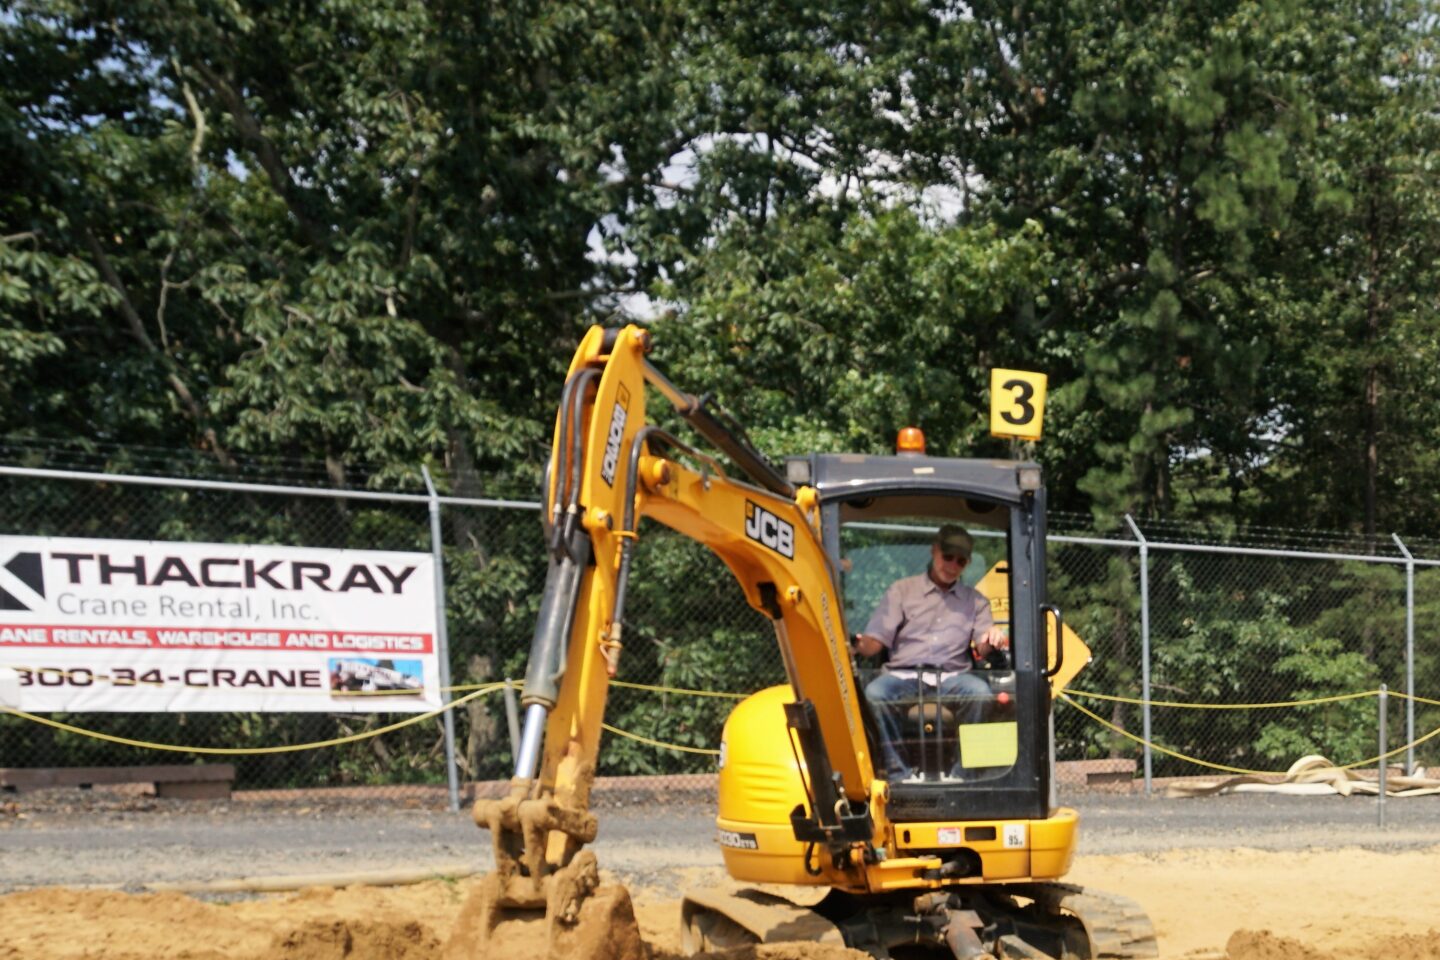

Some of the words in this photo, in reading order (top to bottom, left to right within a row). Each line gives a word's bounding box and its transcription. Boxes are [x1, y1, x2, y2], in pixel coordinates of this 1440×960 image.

[1000, 379, 1035, 426] 3
[745, 506, 794, 558] JCB
[50, 552, 416, 594] THACKRAY
[57, 593, 147, 617] Crane
[160, 596, 260, 620] Rental,
[271, 599, 319, 620] Inc.
[157, 630, 281, 647] WAREHOUSE
[286, 633, 330, 648] AND
[333, 634, 424, 650] LOGISTICS
